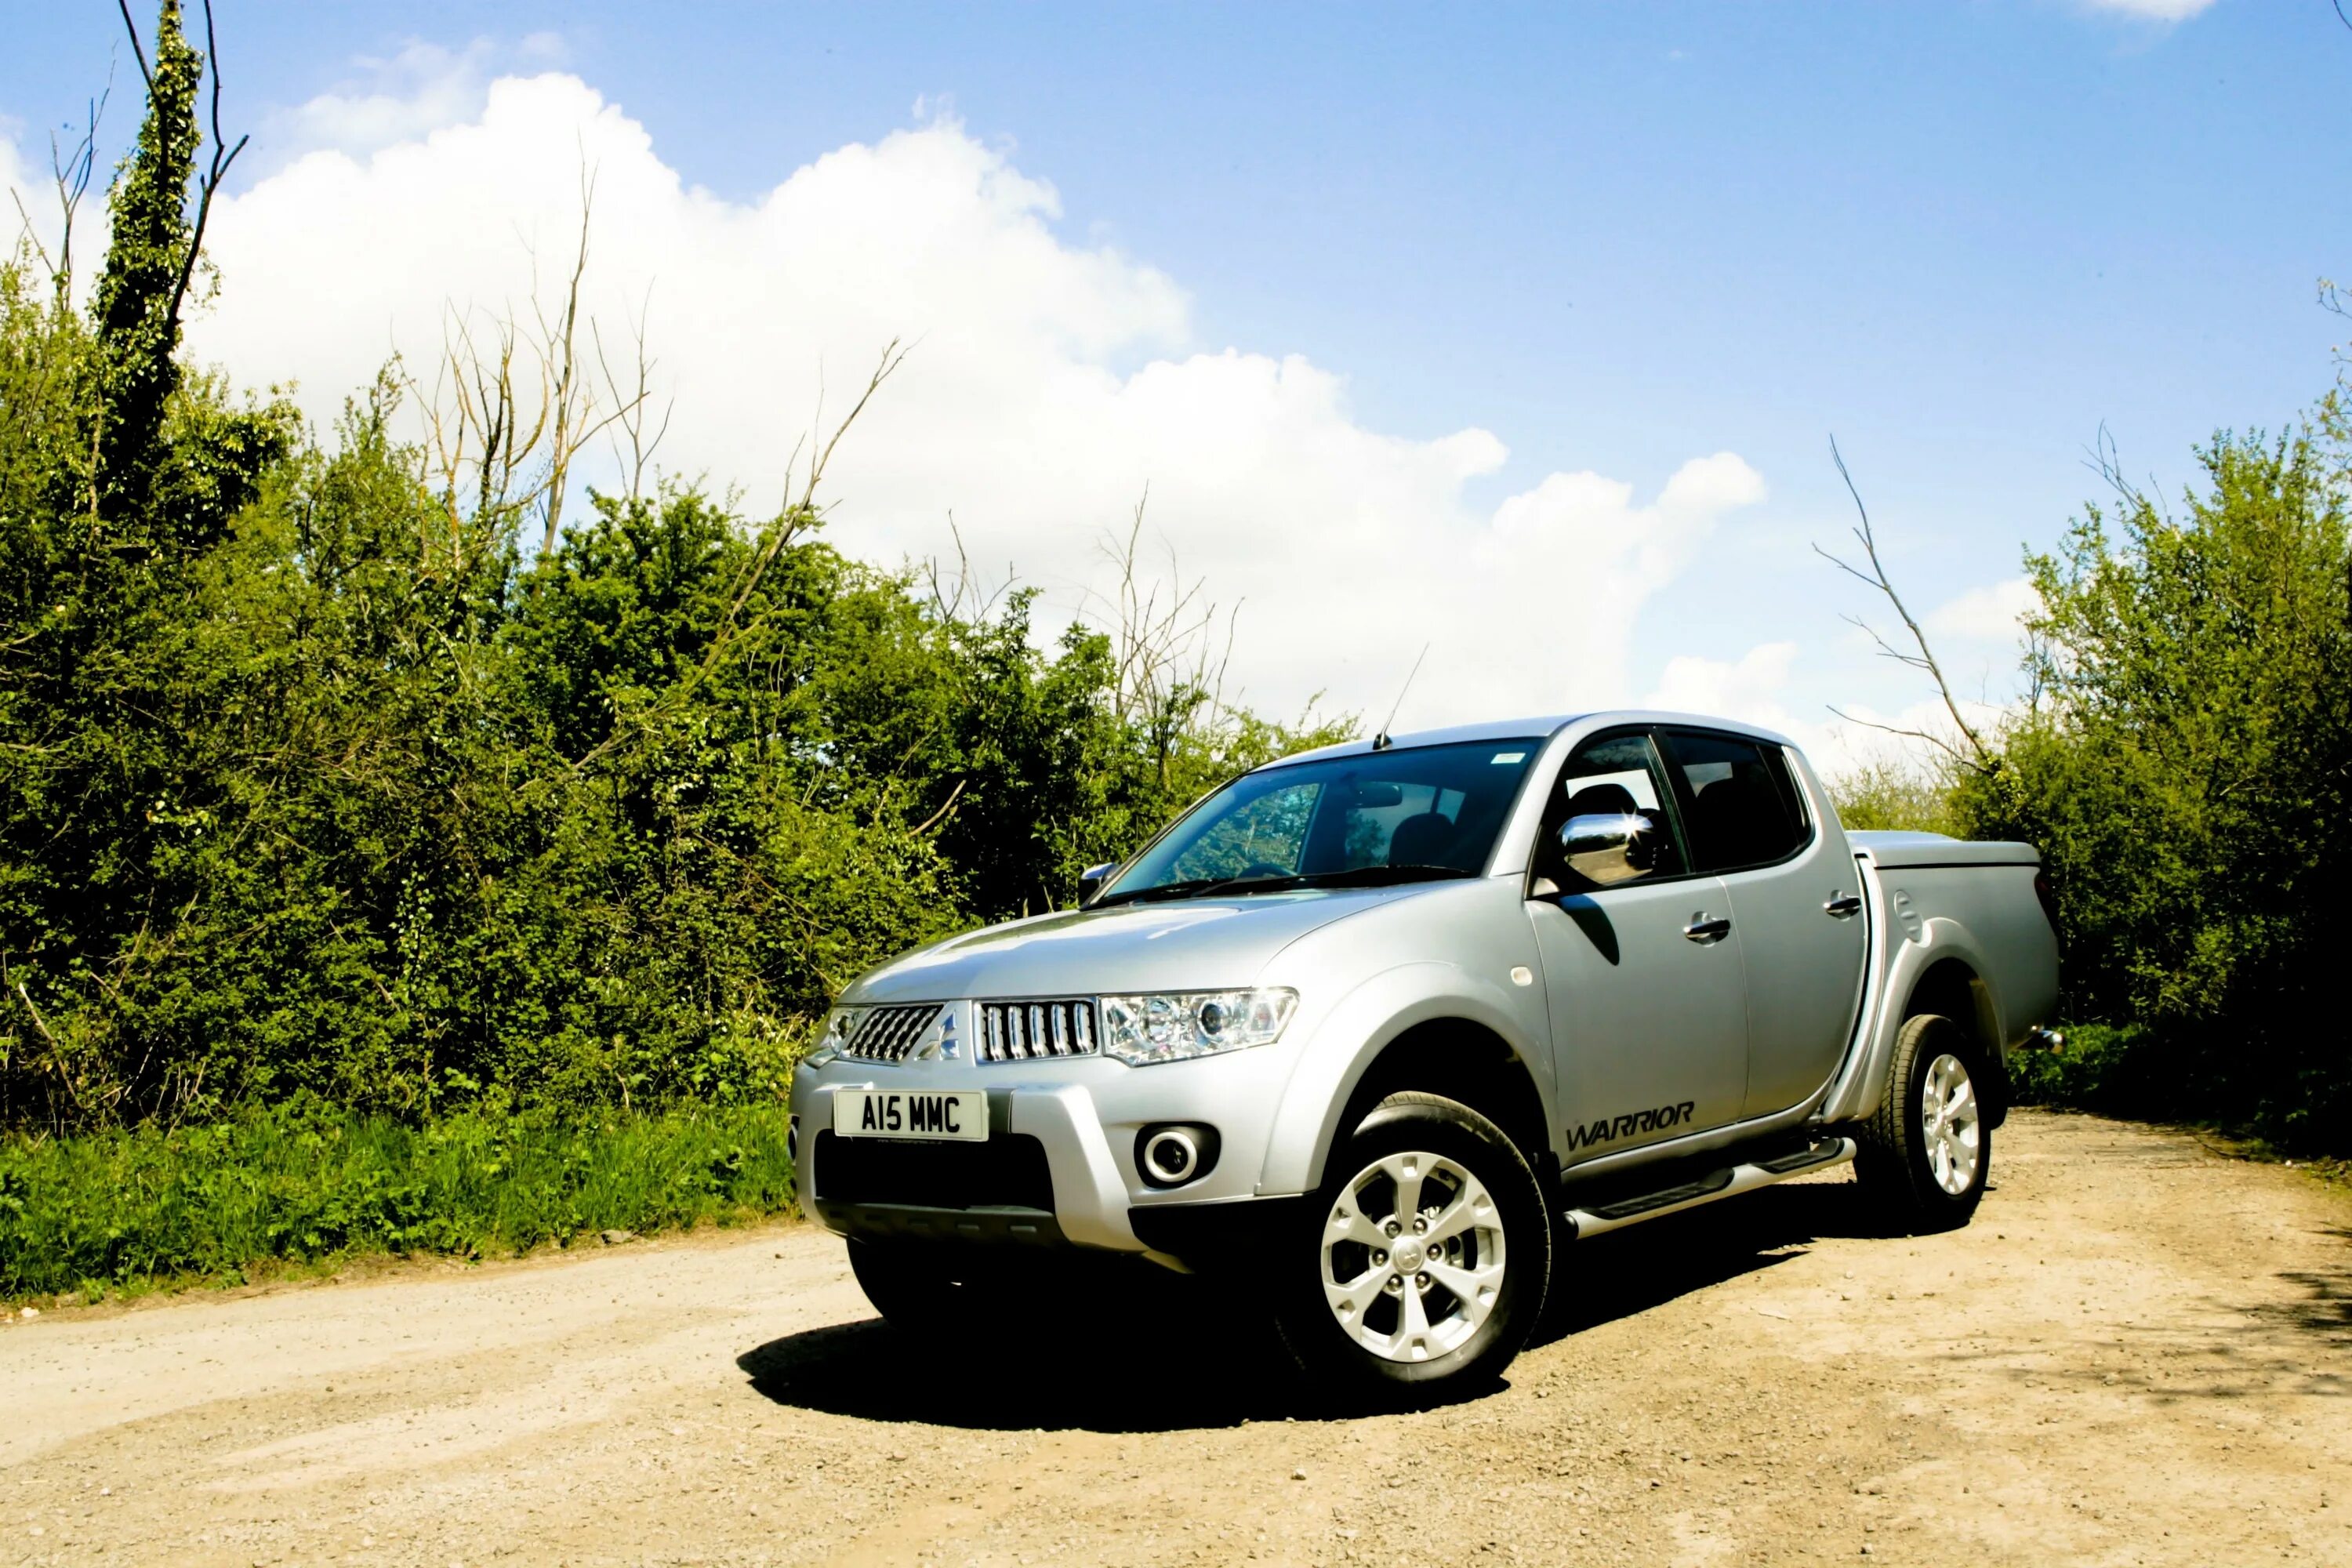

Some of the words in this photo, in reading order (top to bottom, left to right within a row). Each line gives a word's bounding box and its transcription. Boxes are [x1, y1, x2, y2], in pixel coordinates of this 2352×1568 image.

[862, 1095, 902, 1131] A15
[909, 1095, 960, 1134] MMC
[1566, 1101, 1695, 1152] WARRIOR
